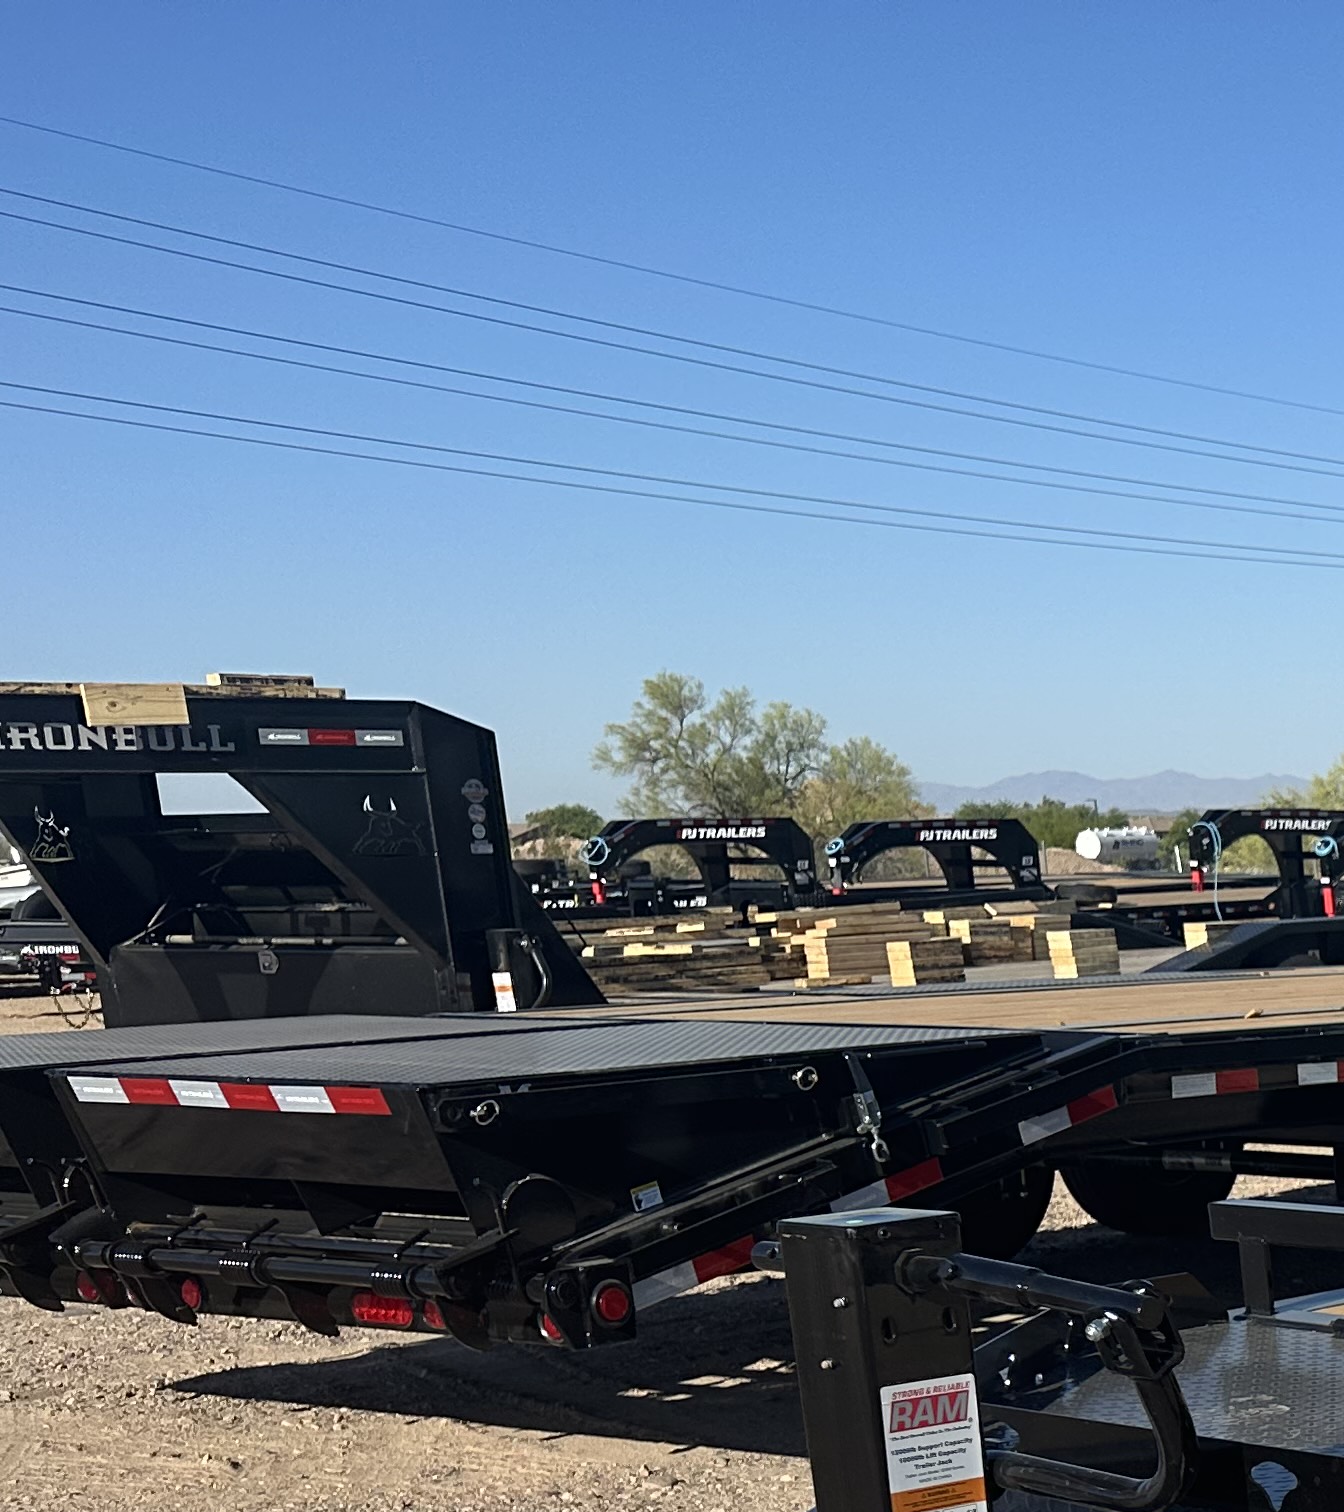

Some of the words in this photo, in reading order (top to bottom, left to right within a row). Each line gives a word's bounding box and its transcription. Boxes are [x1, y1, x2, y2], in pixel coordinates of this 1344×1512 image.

[0, 723, 235, 752] RONBULL
[1265, 819, 1278, 830] PJ
[682, 828, 697, 839] PJ
[698, 826, 766, 839] TRAILERS
[919, 830, 934, 841] PJ
[934, 828, 998, 840] TRAILERS
[892, 1388, 924, 1400] STRONG
[926, 1386, 931, 1394] &
[932, 1381, 970, 1394] RELIABLE
[891, 1392, 967, 1431] RAM
[918, 1442, 943, 1452] Support
[944, 1438, 973, 1447] Capacity
[938, 1447, 967, 1457] Capacity
